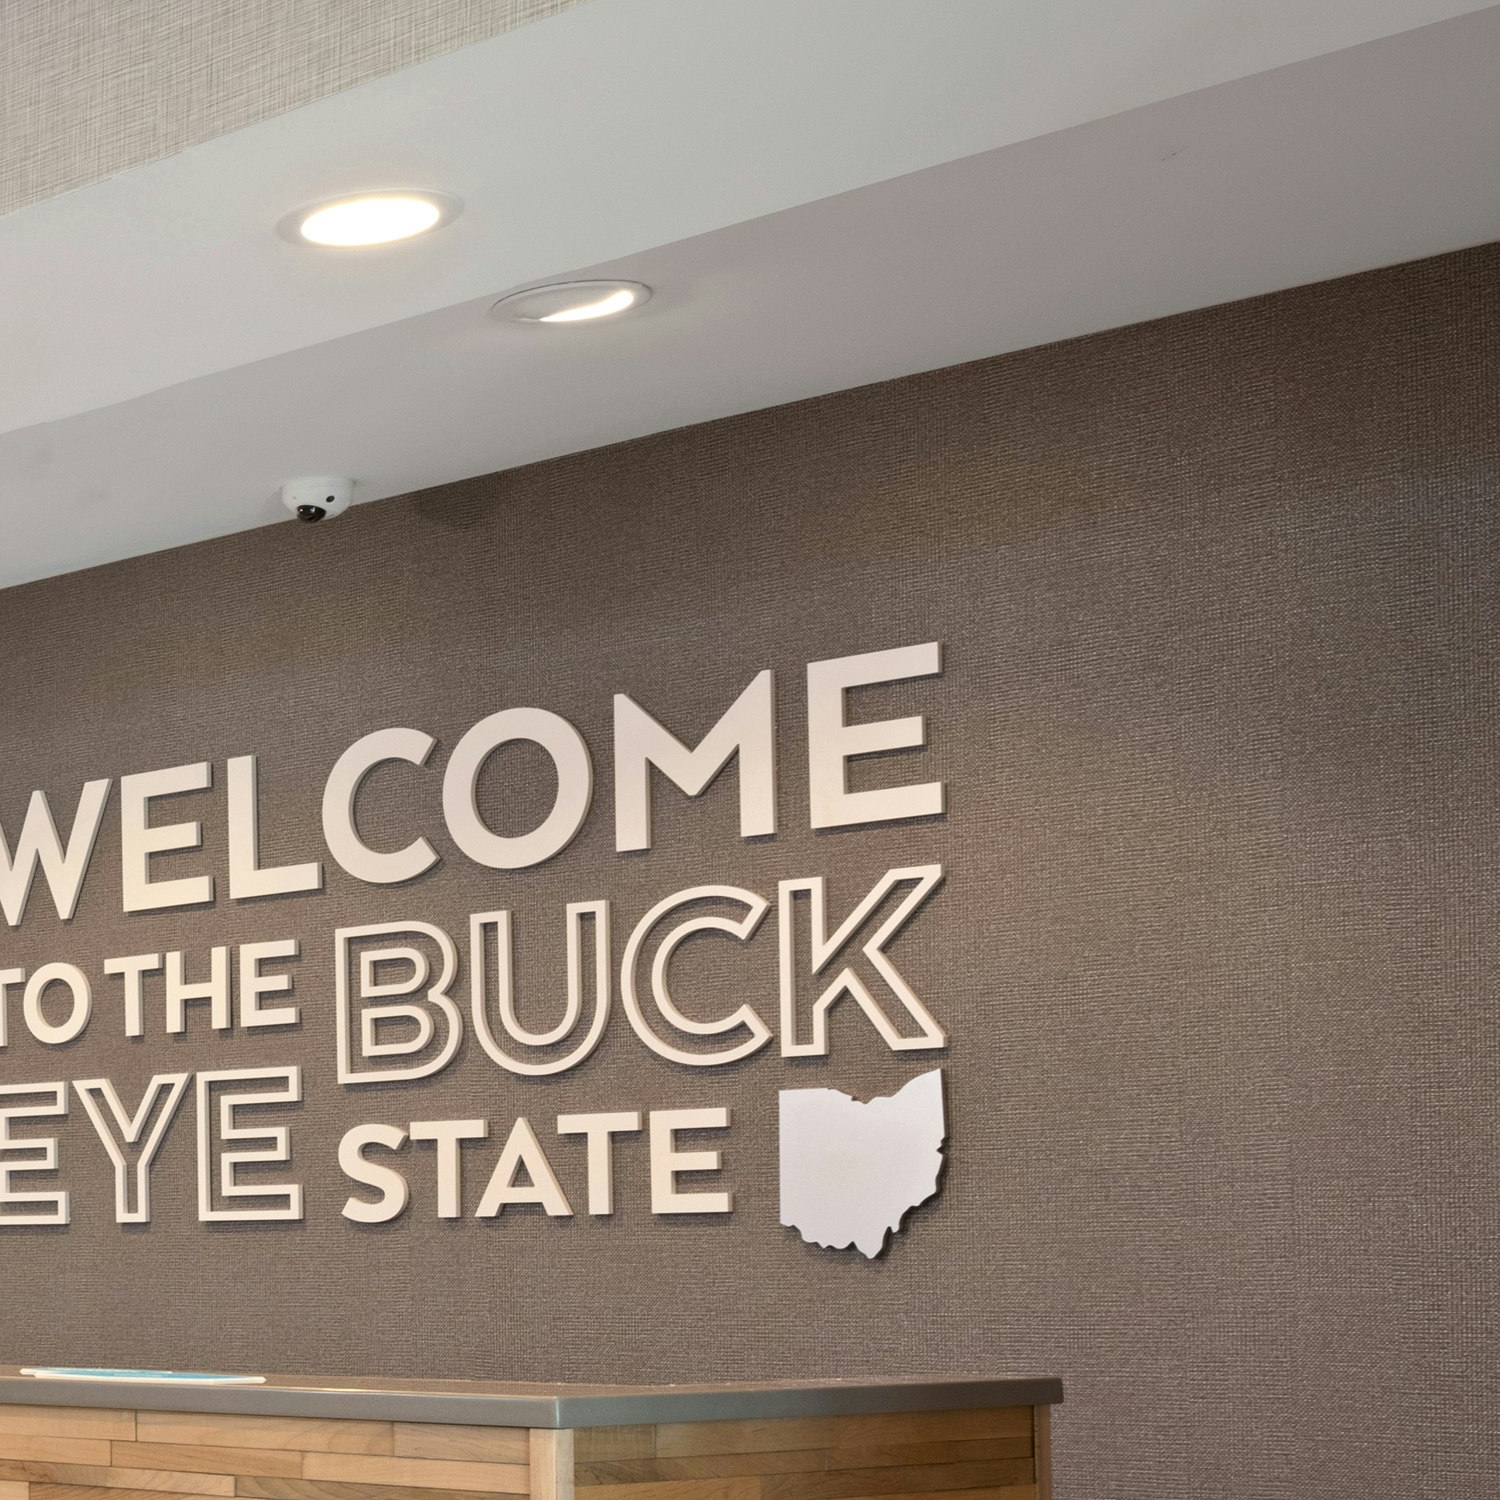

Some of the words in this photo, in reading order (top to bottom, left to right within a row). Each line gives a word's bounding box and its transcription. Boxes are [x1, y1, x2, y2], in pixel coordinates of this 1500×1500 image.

[104, 939, 301, 1037] THE
[334, 863, 948, 1086] BUCK
[336, 1107, 734, 1224] STATE
